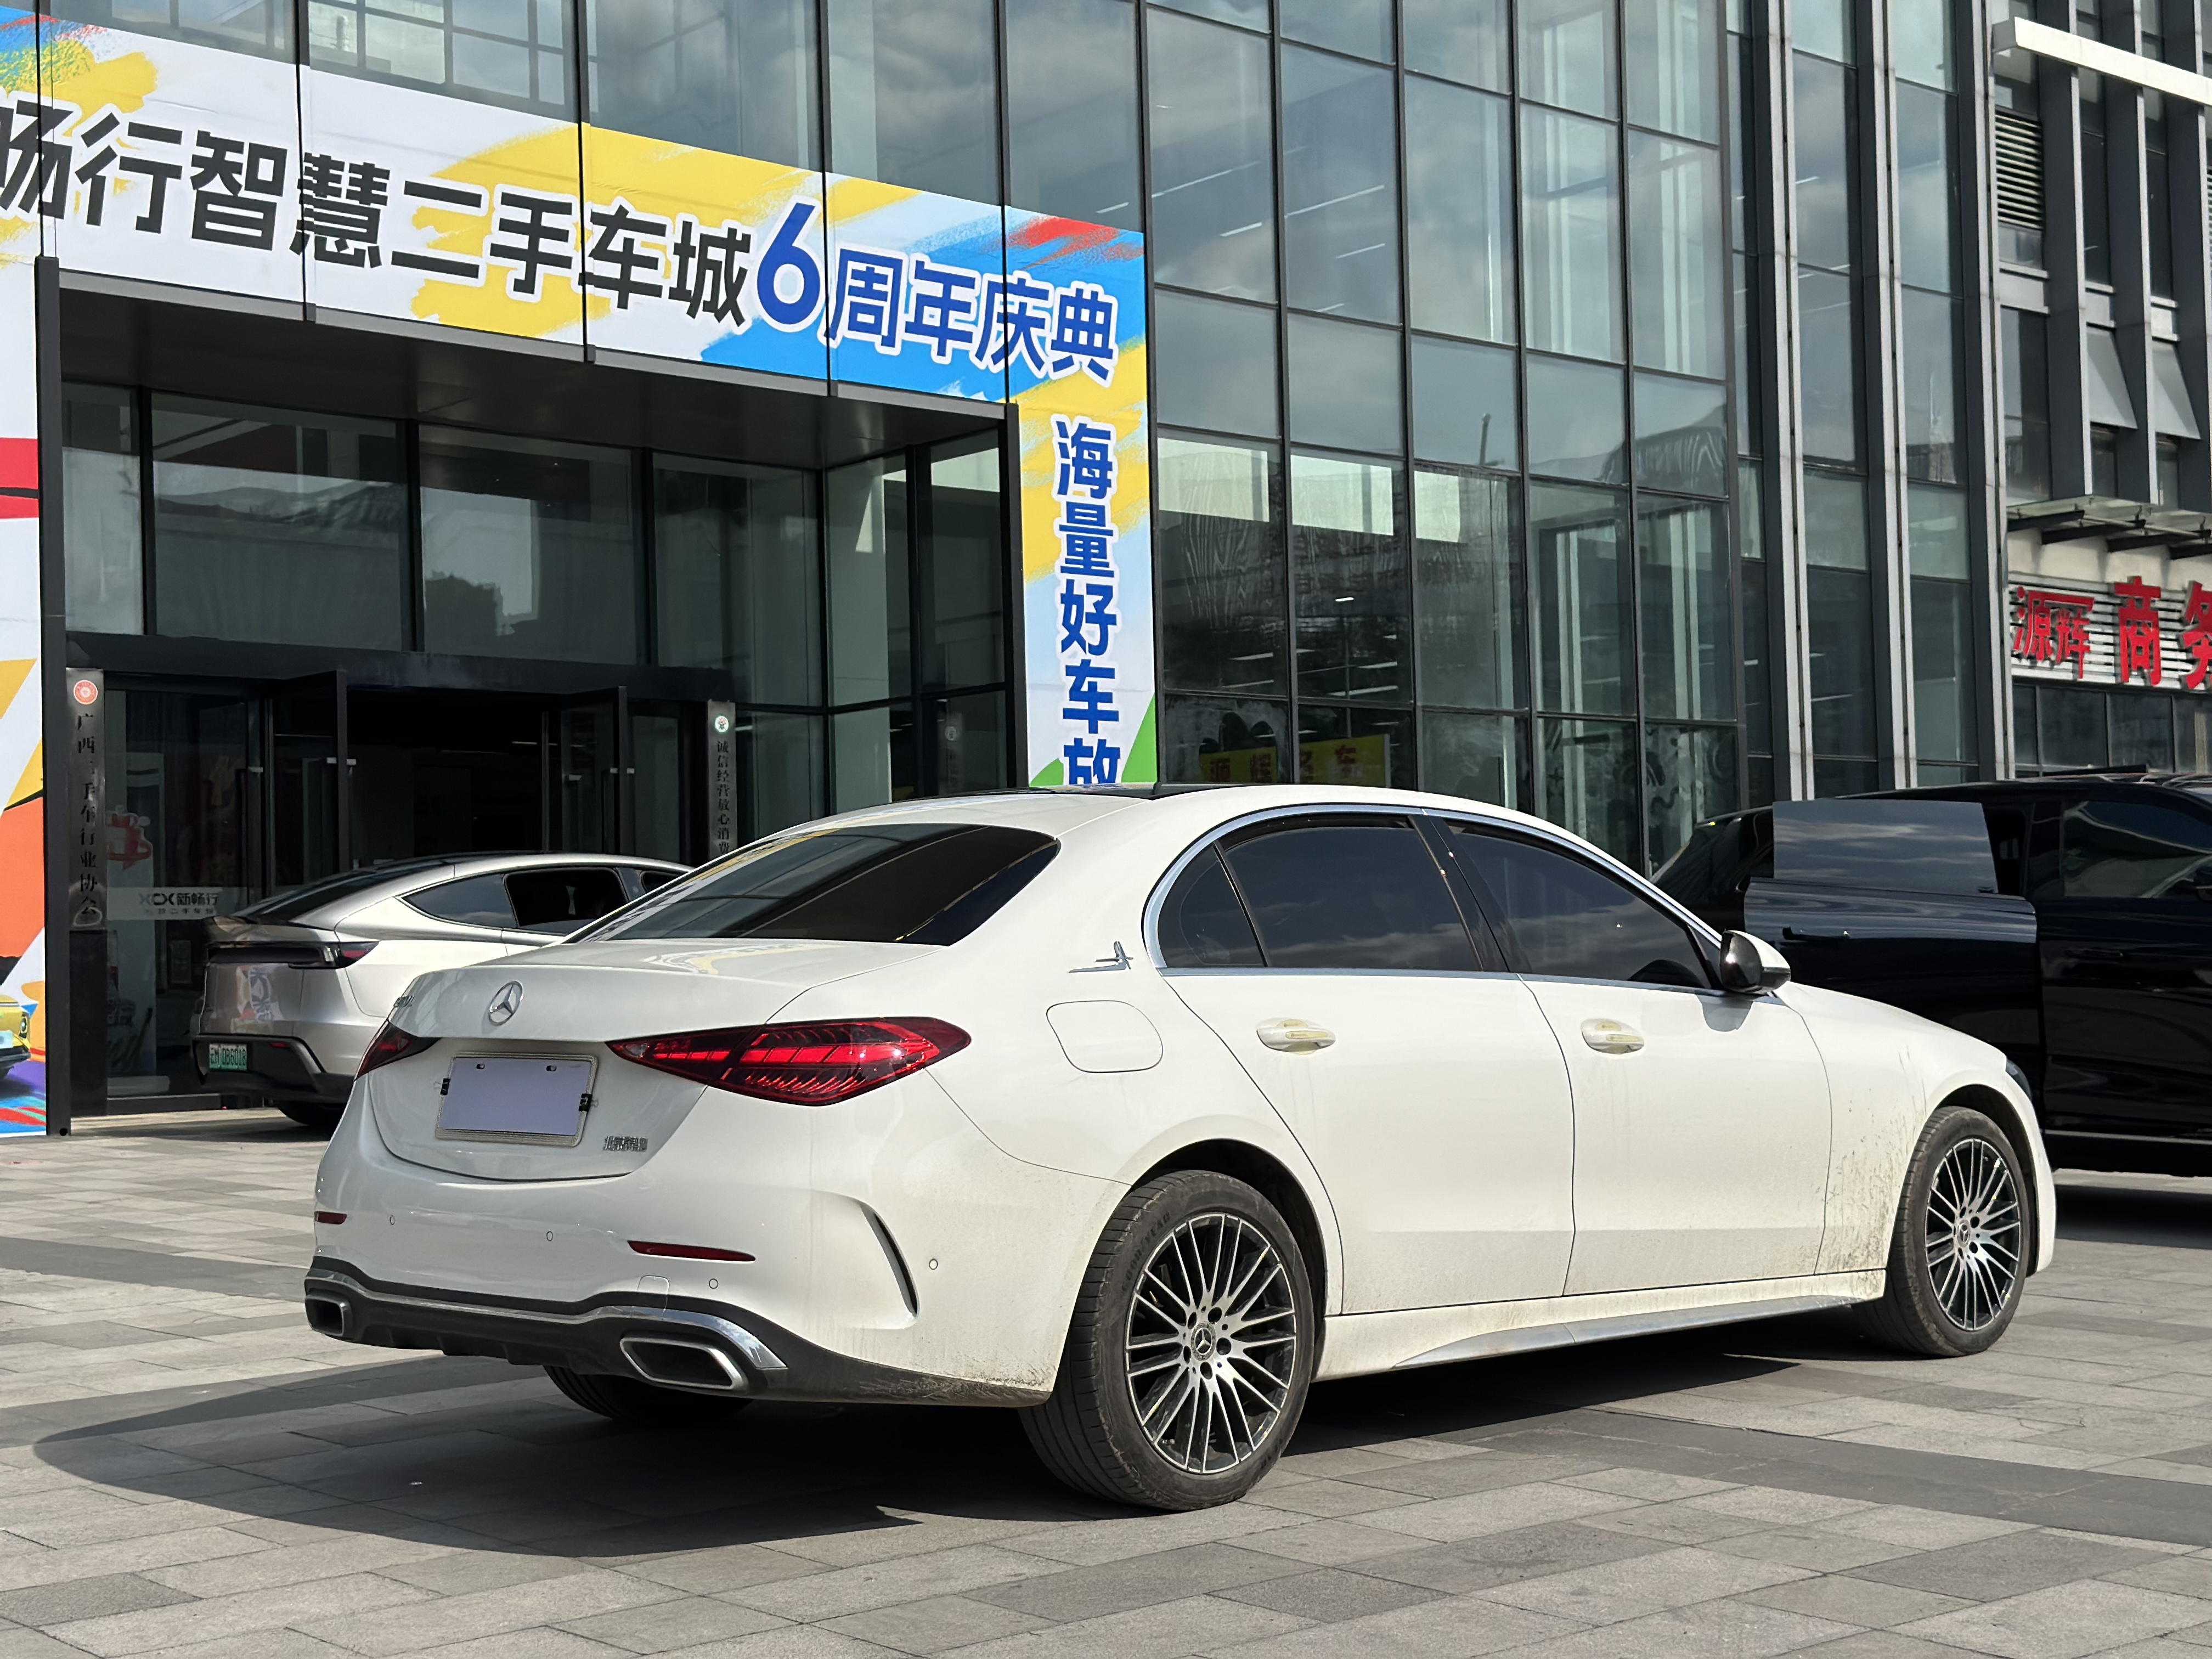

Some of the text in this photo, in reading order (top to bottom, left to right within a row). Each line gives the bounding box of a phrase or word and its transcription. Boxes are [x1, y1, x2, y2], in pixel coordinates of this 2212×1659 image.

[1056, 420, 1121, 785] 海量好车放
